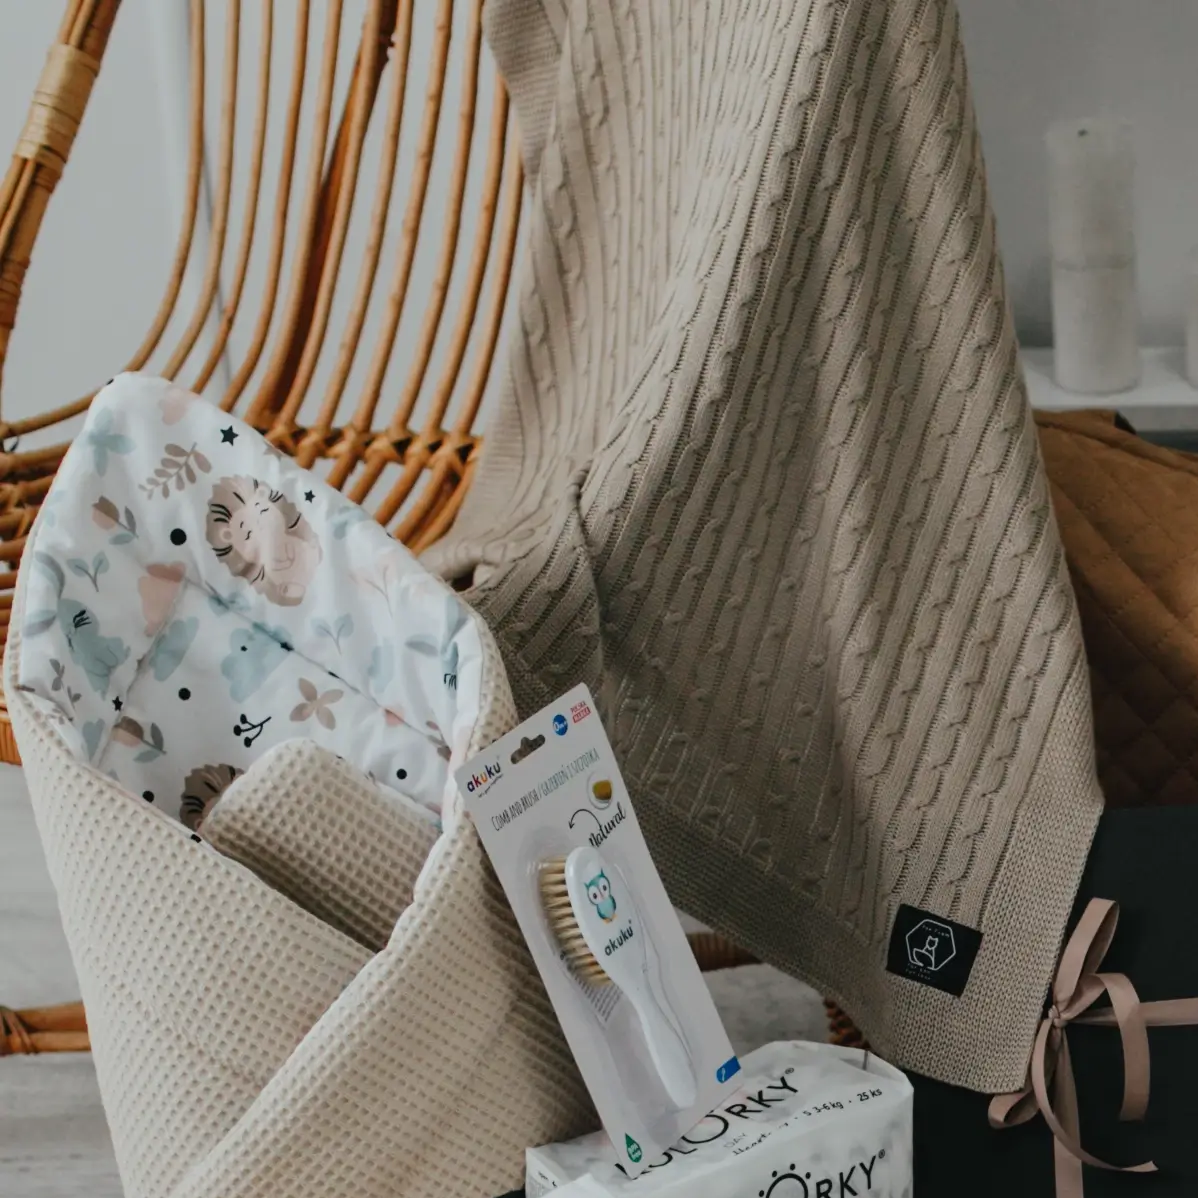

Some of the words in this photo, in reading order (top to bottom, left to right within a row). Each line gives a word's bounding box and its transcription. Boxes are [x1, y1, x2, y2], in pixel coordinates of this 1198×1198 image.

[467, 761, 501, 792] akuku
[588, 801, 627, 848] Natural
[604, 926, 634, 957] akuku
[856, 1090, 870, 1102] 25
[870, 1088, 883, 1099] ks
